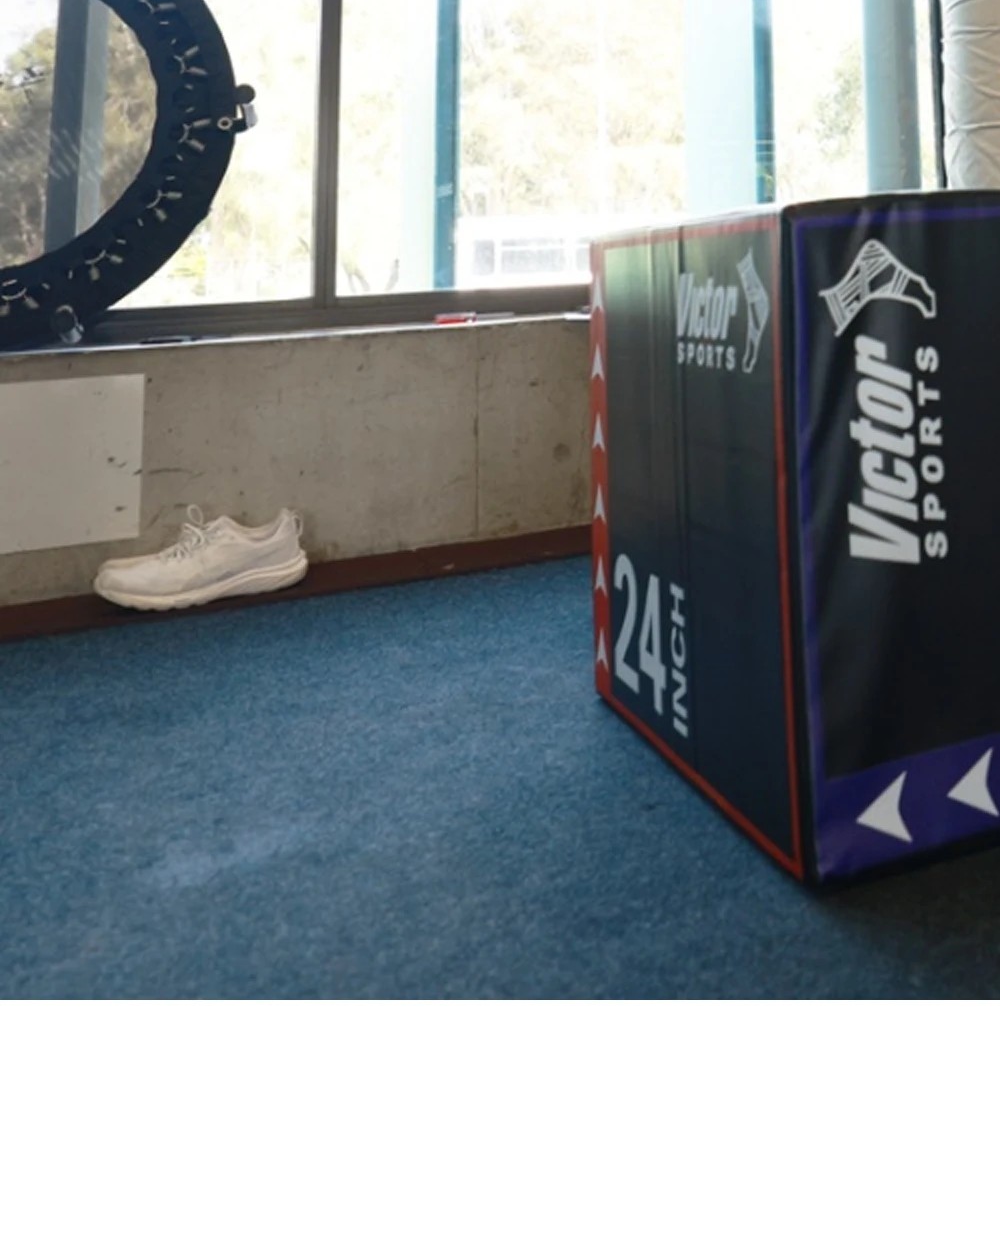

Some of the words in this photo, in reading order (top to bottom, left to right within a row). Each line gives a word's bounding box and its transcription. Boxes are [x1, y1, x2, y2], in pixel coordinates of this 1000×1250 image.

[677, 341, 736, 371] SPORTS
[847, 334, 921, 565] Victor
[914, 345, 950, 559] SPORTS
[613, 553, 667, 716] 24
[669, 581, 689, 738] INCH
